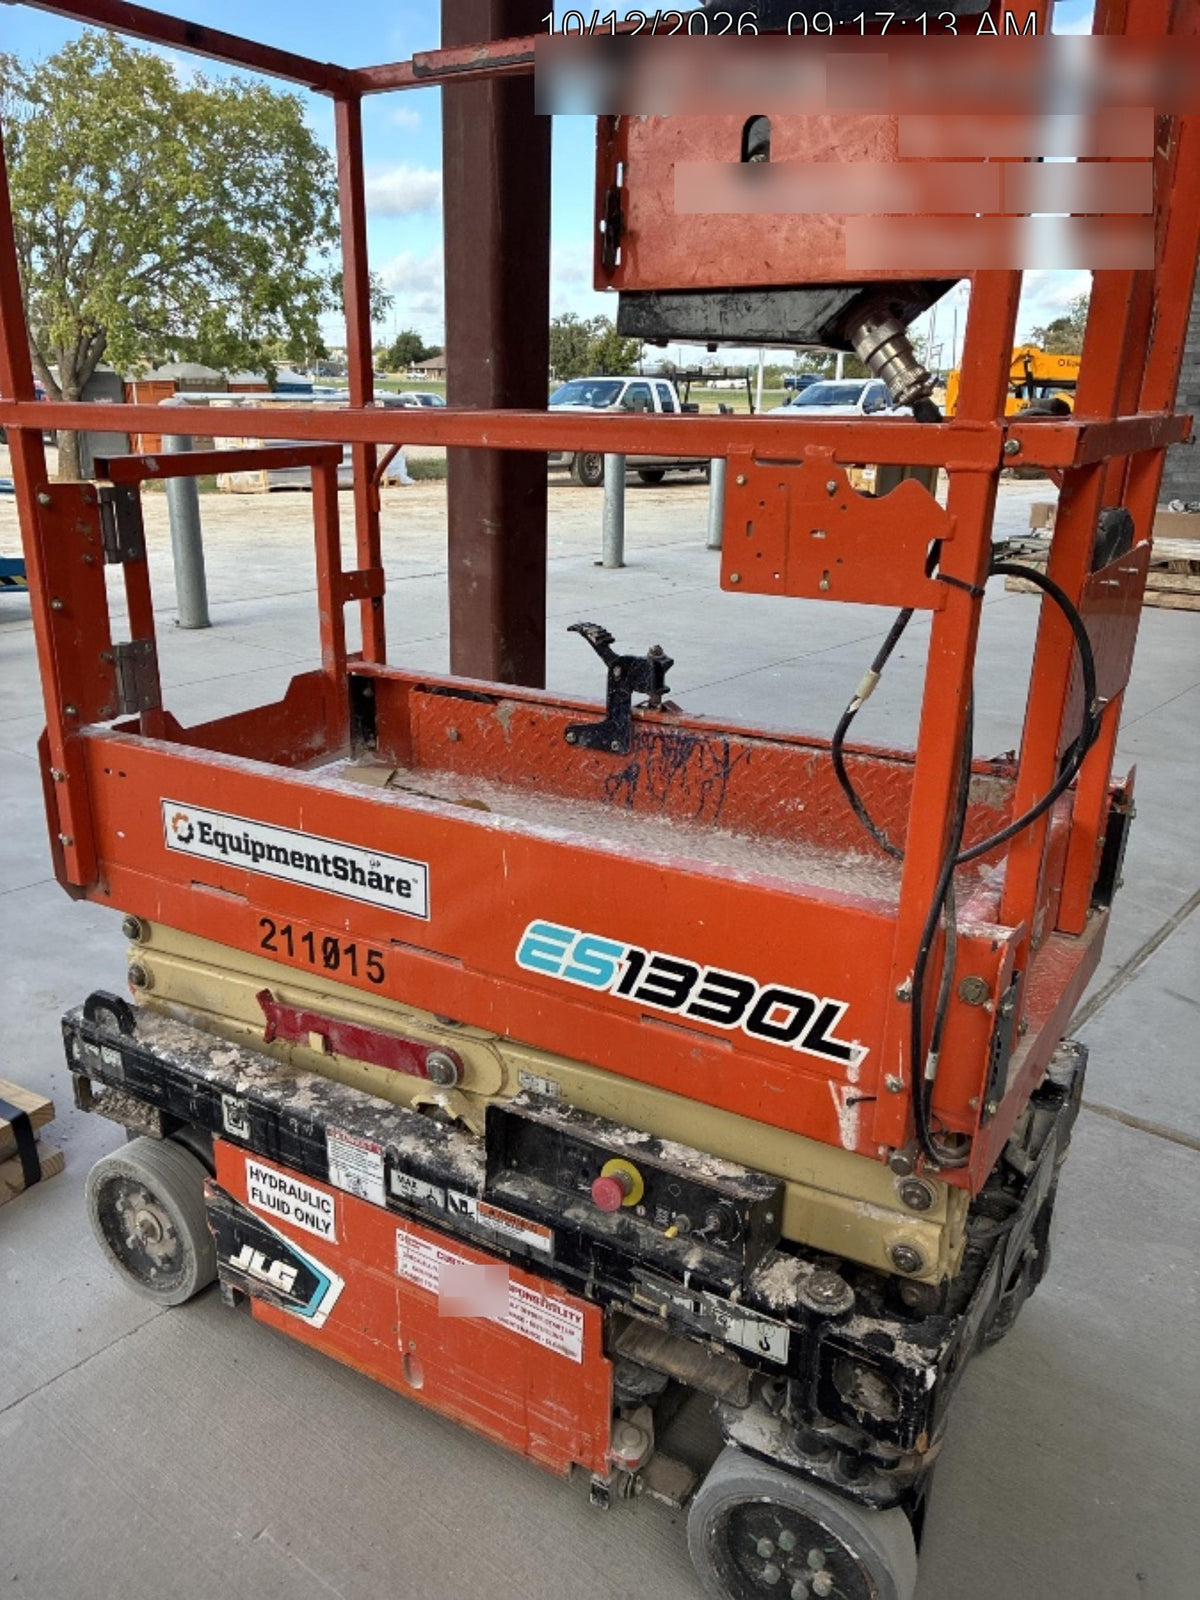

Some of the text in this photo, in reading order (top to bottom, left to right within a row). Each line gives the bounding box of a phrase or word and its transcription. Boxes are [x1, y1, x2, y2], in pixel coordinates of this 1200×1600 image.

[197, 820, 412, 899] EquipmentShare
[259, 917, 386, 985] 211015
[516, 920, 866, 1065] ES1330L
[249, 1165, 332, 1214] HYDRAULIC
[250, 1187, 332, 1235] FLUID ONLY
[228, 1243, 299, 1294] JLG
